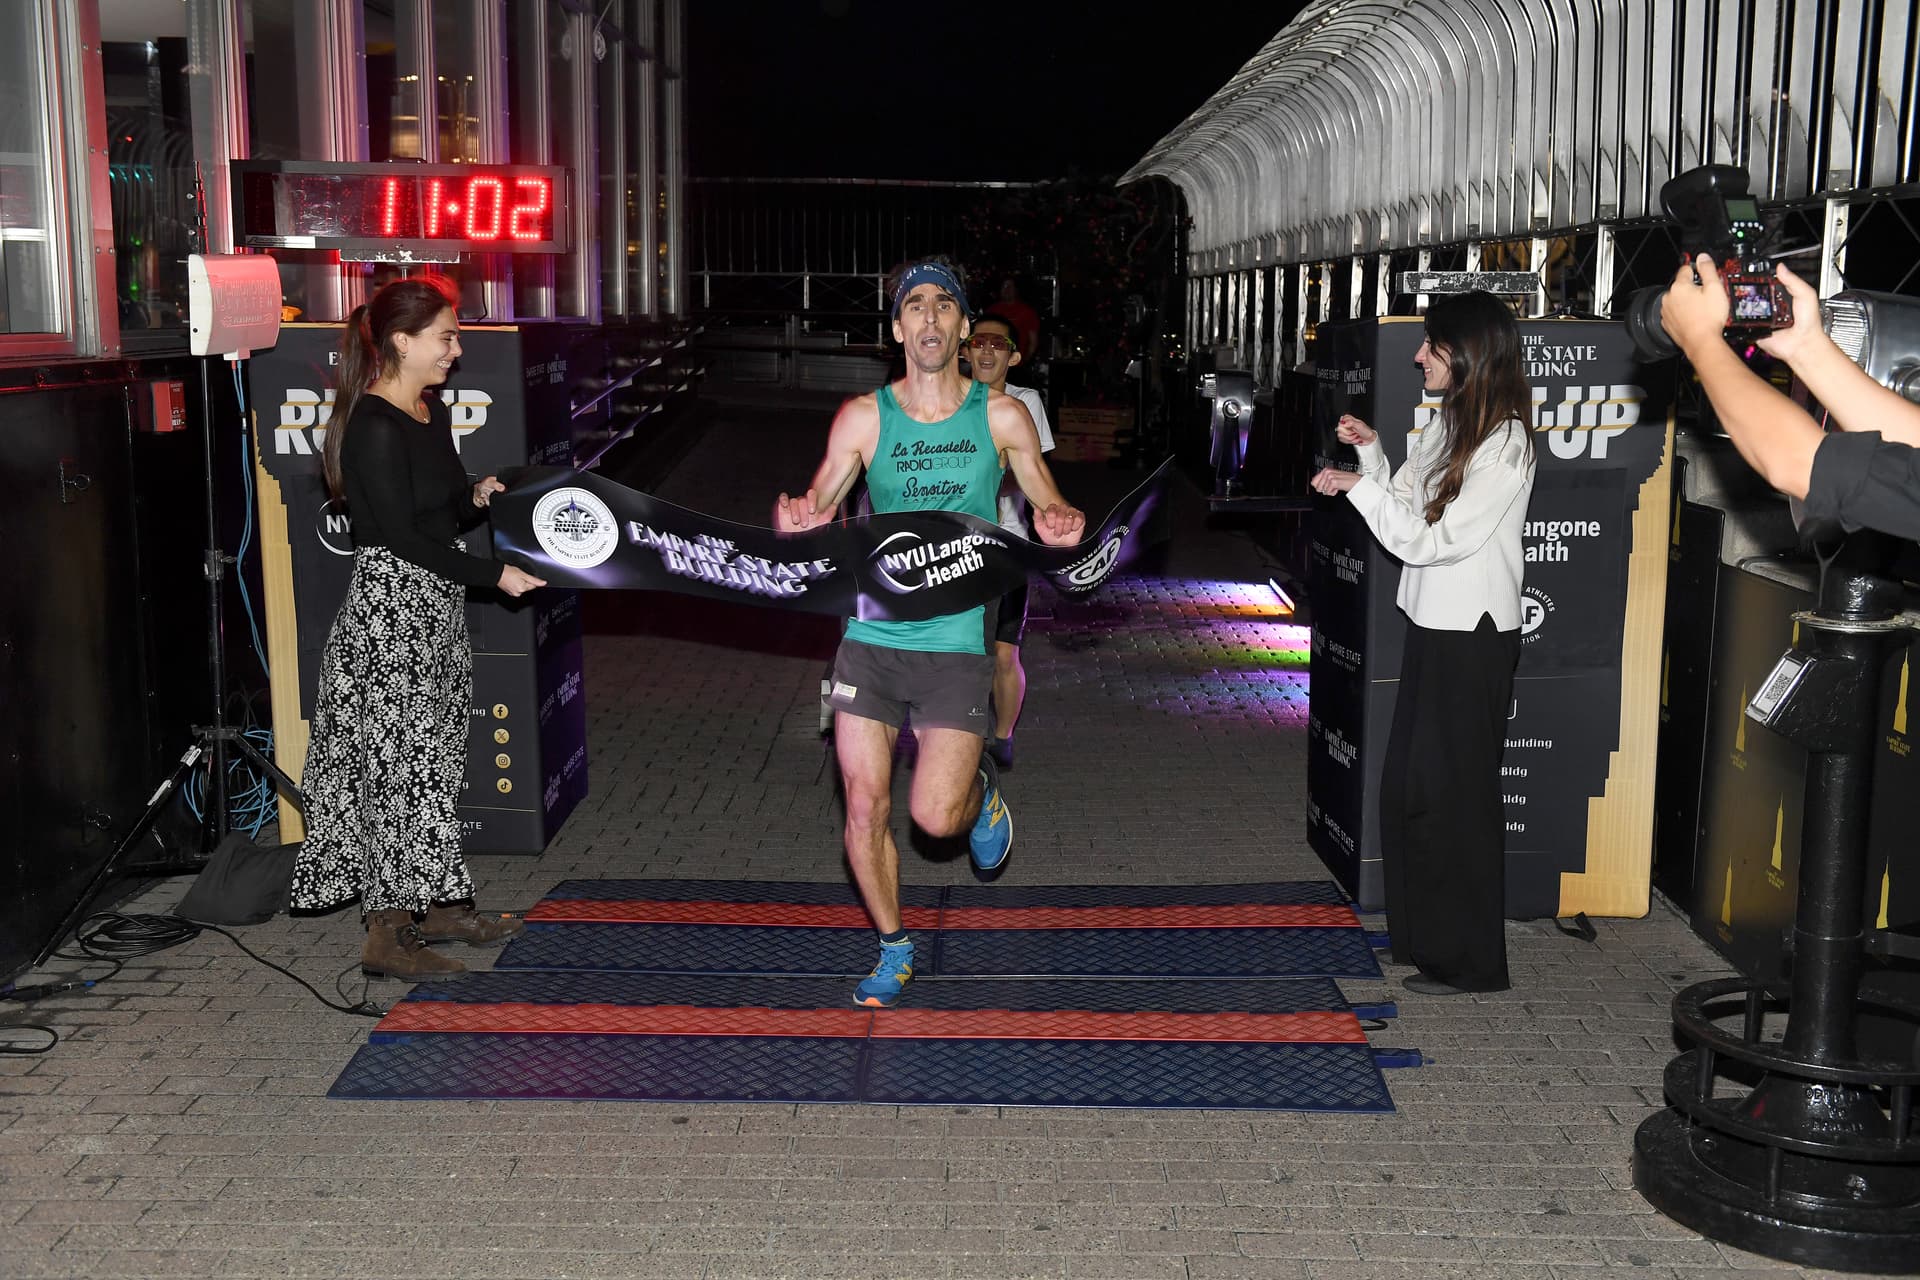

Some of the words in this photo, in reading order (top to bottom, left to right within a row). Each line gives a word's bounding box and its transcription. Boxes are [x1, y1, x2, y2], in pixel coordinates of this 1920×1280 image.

[1522, 335, 1545, 346] THE
[1543, 346, 1598, 361] STATE
[890, 442, 908, 458] La
[902, 476, 967, 498] Sensitive
[699, 533, 739, 551] THE
[1523, 520, 1601, 541] angone
[628, 520, 736, 566] EMPIRE
[739, 554, 837, 579] STATE
[884, 545, 927, 570] NYU
[927, 534, 1009, 562] Langone
[1075, 541, 1117, 580] CAF
[1524, 541, 1570, 562] alth
[665, 550, 808, 595] BUILDING
[925, 550, 985, 588] Health
[1069, 561, 1119, 592] FOUNDATION
[1525, 586, 1555, 612] ATHLETES
